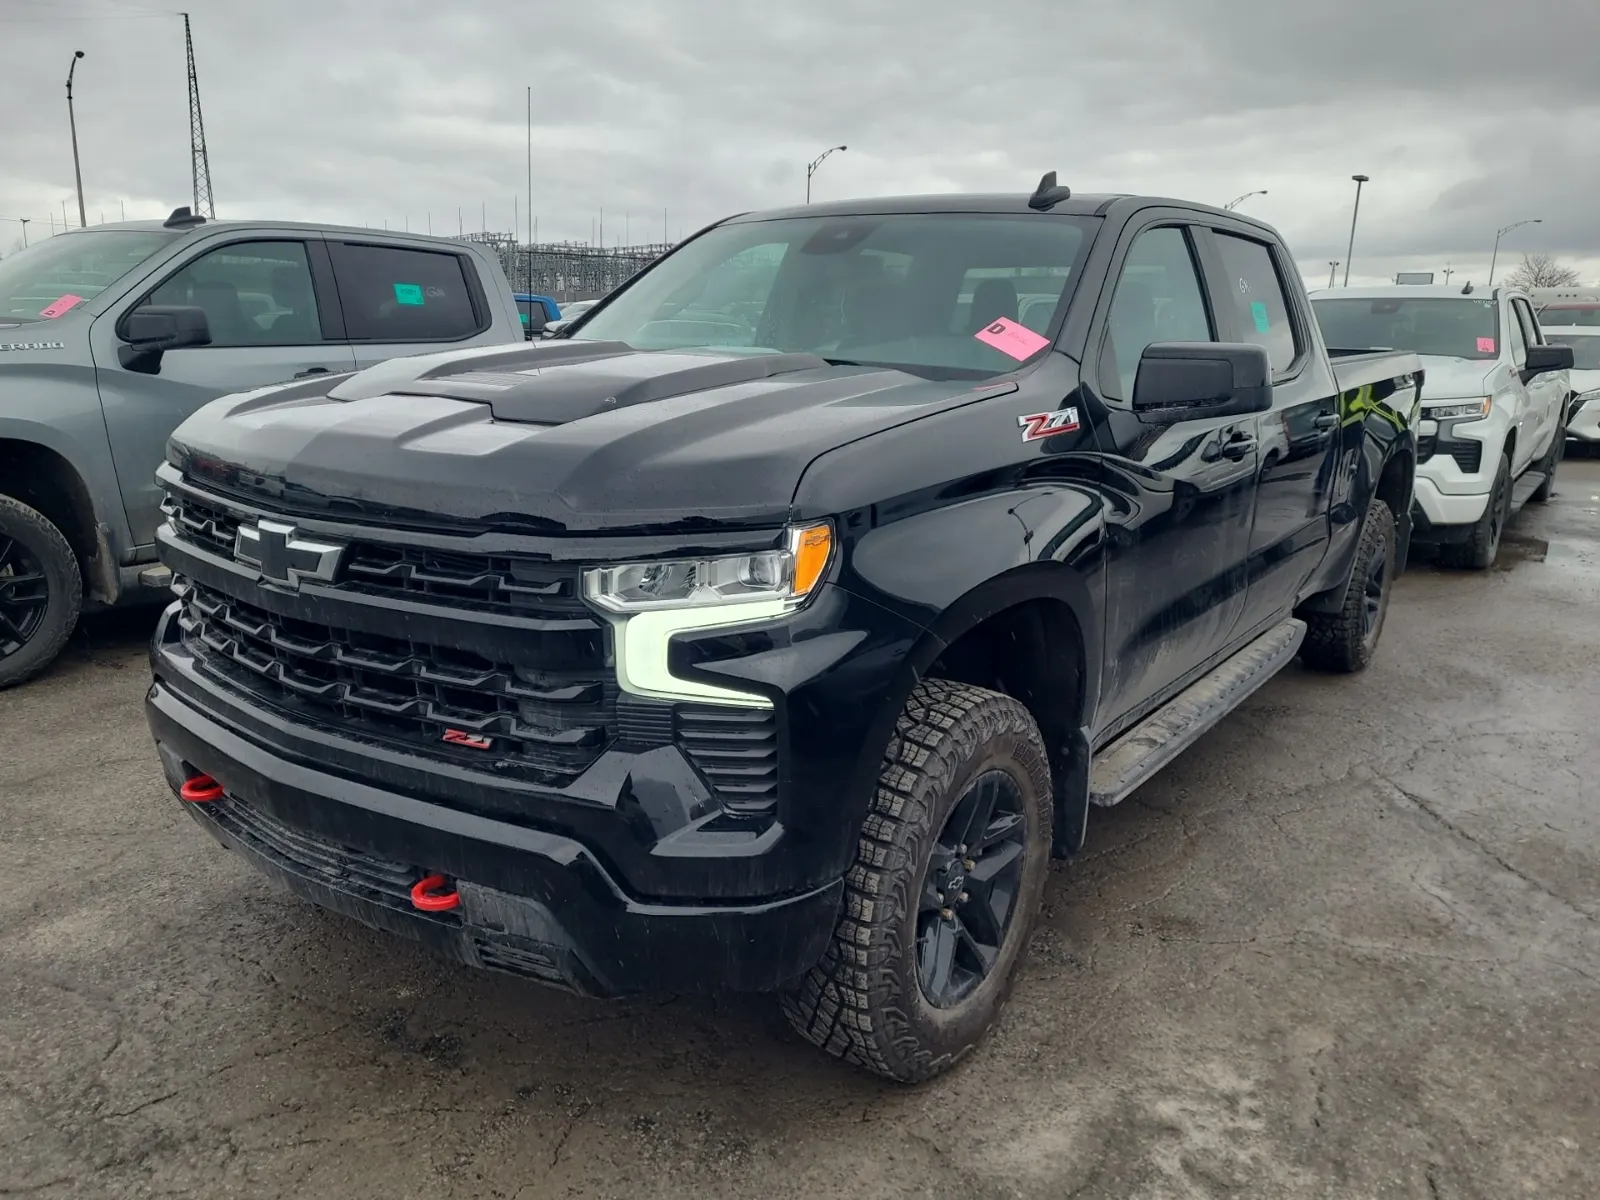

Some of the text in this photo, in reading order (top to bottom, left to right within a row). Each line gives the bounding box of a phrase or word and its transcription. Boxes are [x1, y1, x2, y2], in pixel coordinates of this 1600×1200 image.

[987, 322, 1006, 335] D
[1017, 406, 1080, 443] Z71
[442, 728, 494, 750] Z71
